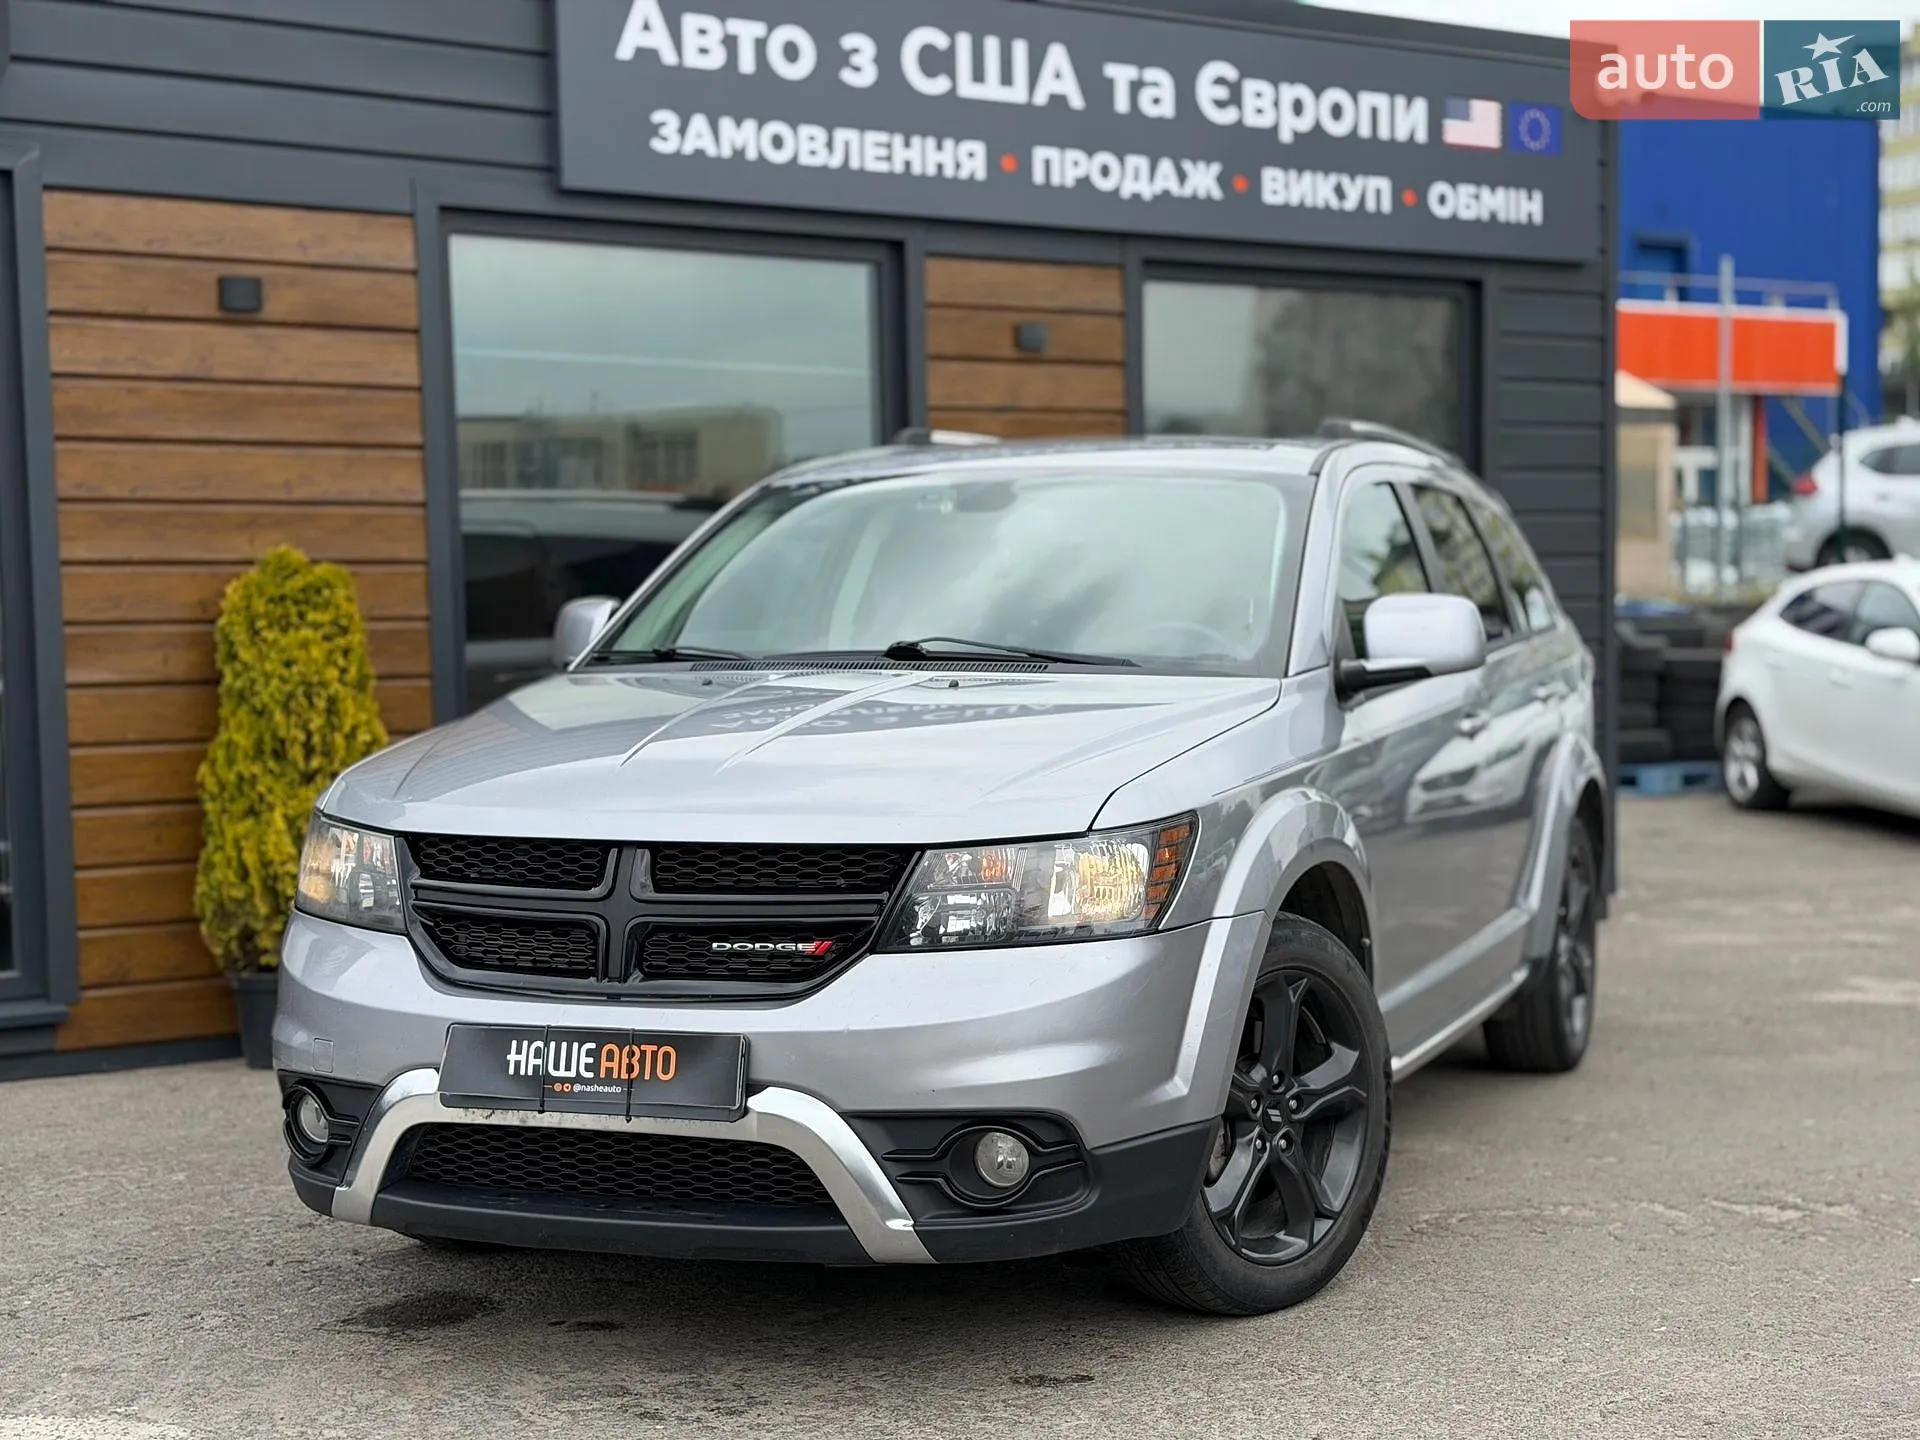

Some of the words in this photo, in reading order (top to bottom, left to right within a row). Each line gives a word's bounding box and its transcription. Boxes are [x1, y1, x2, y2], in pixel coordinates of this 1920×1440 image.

[614, 0, 818, 81] Авто
[838, 33, 879, 89] з
[900, 26, 1086, 110] США
[1103, 63, 1177, 119] та
[1195, 61, 1429, 144] Європи
[649, 109, 987, 182] ЗАМОВЛЕННЯ
[1031, 146, 1223, 201] ПРОДАЖ
[1261, 166, 1393, 215] ВИКУП
[1427, 180, 1544, 226] ОБМІН
[712, 942, 816, 952] DODGE
[507, 1040, 597, 1079] НАШЕ
[600, 1043, 678, 1082] АВТО
[572, 1083, 622, 1093] @nasheauto
